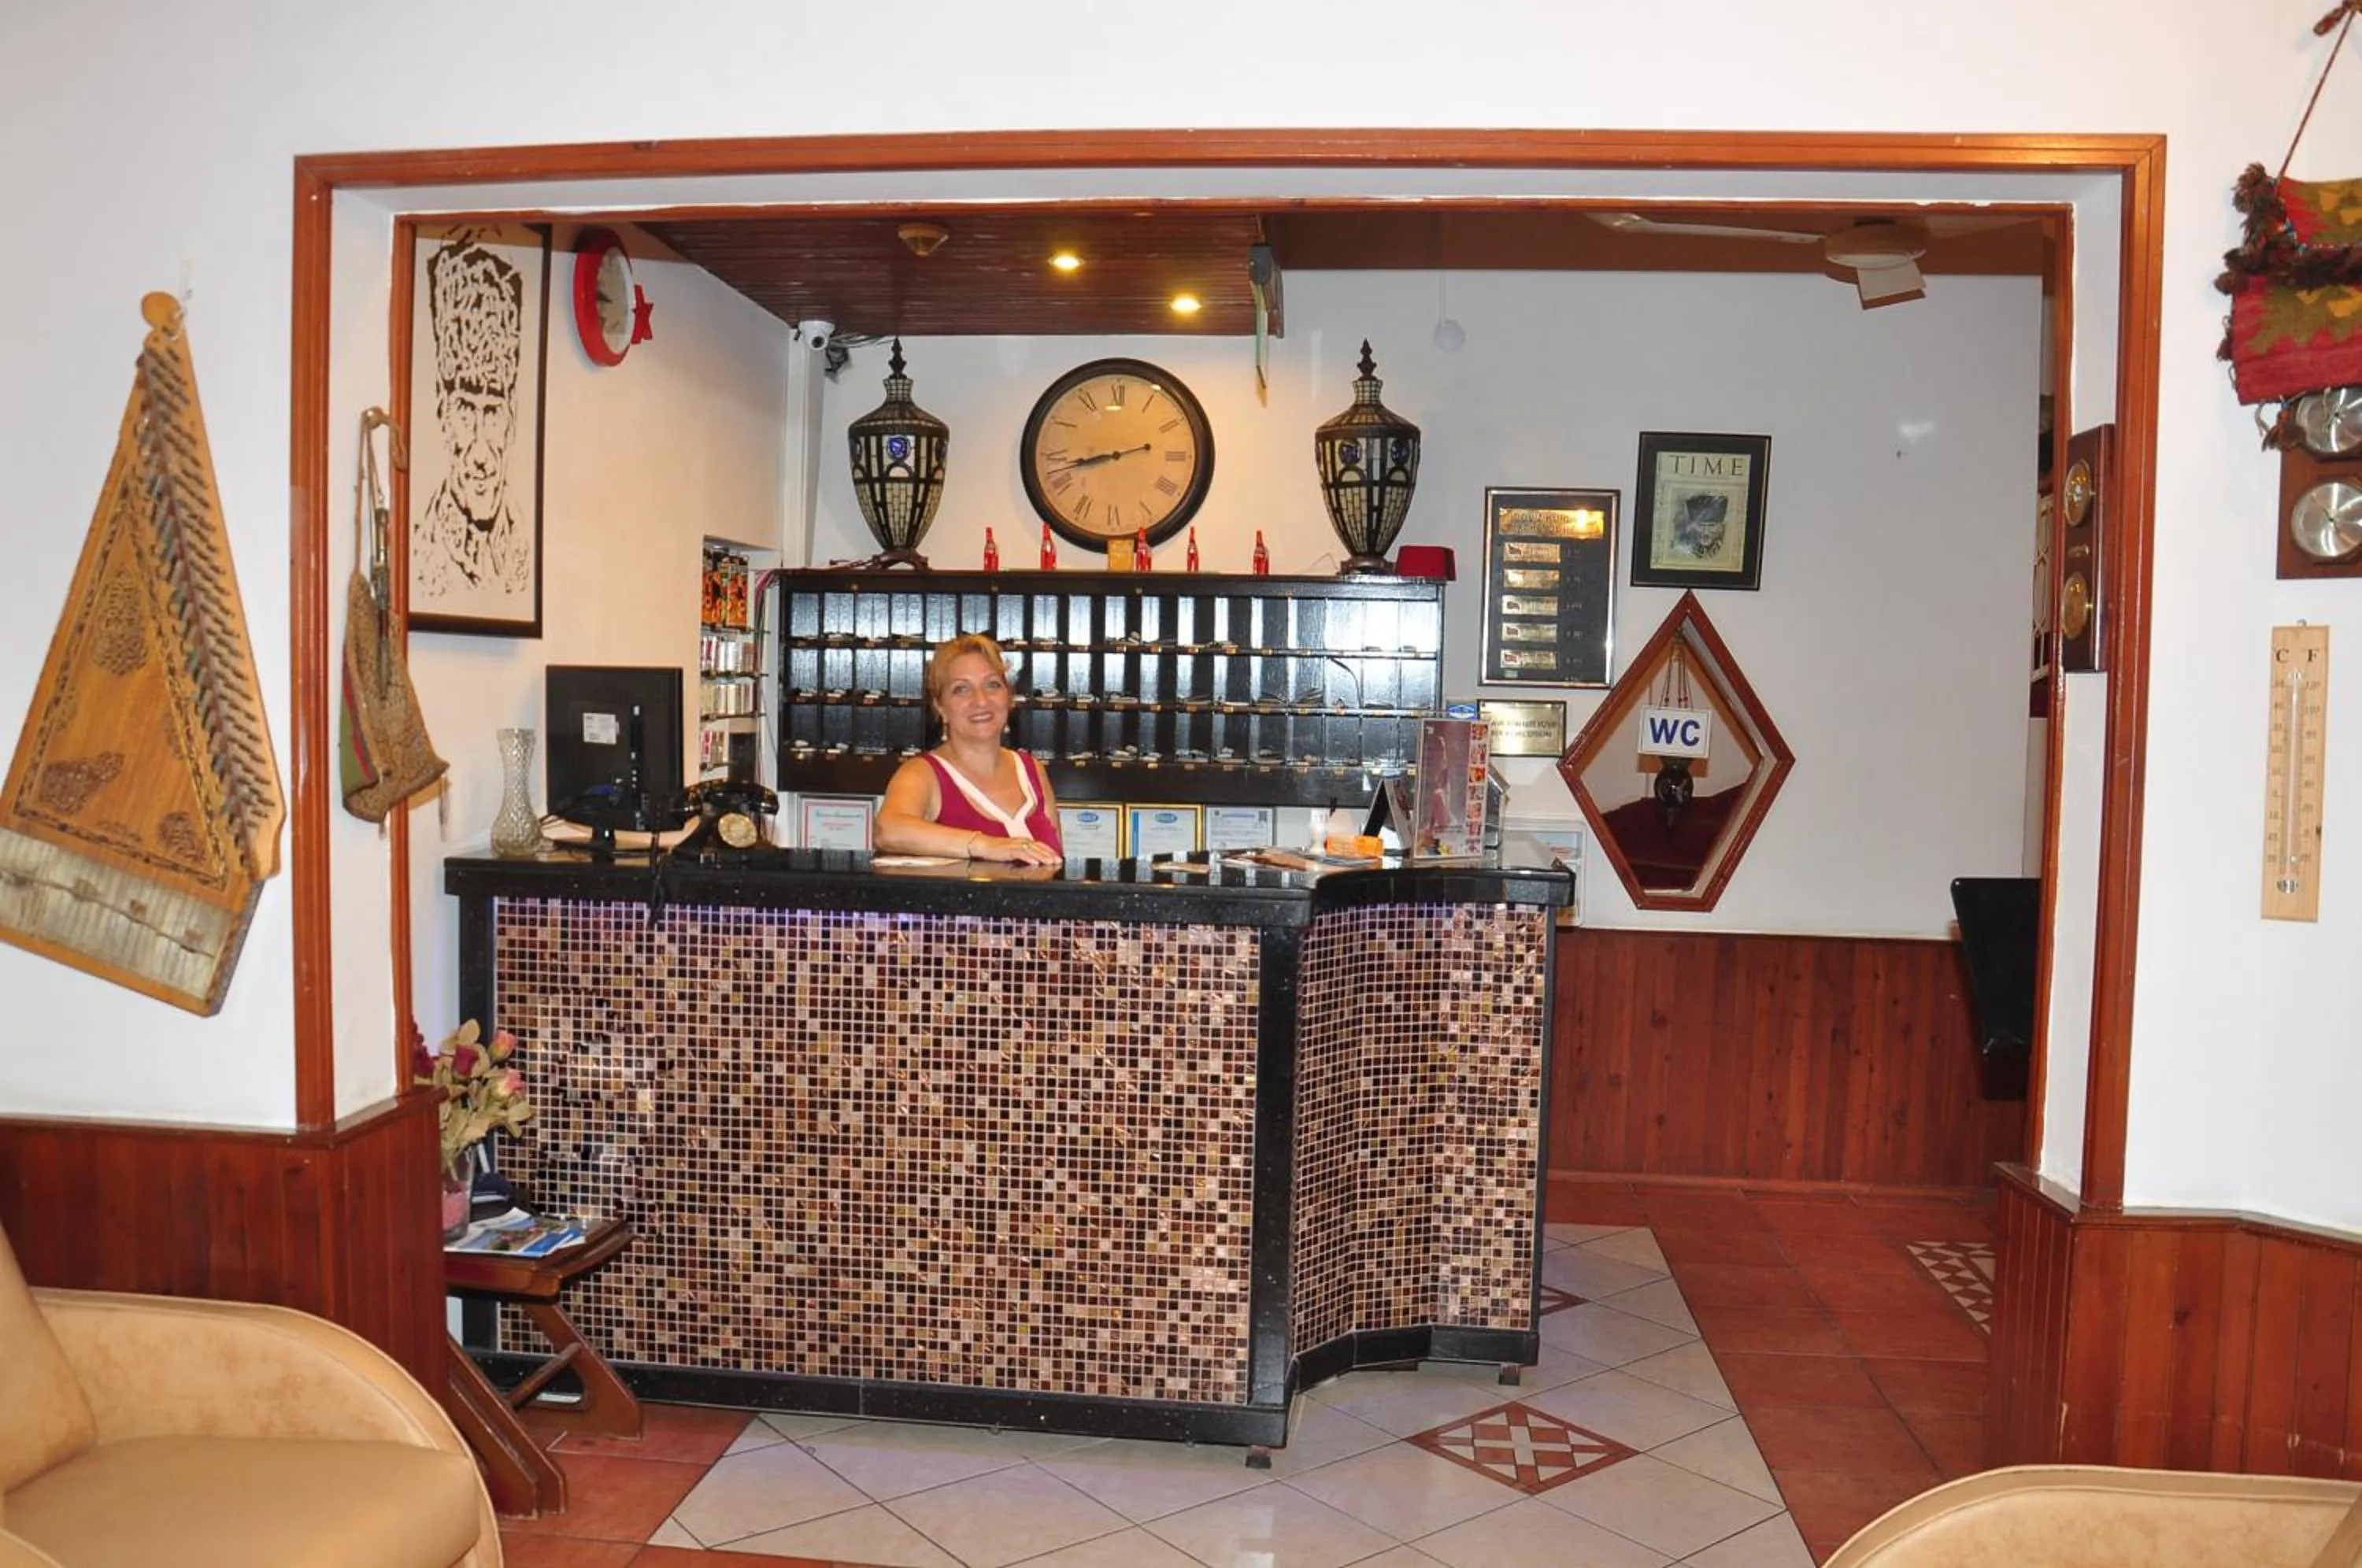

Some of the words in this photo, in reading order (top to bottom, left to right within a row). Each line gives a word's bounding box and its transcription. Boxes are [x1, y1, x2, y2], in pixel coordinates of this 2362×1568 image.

[1142, 394, 1154, 413] I
[1158, 418, 1179, 435] II
[1165, 451, 1187, 462] III
[1669, 454, 1743, 476] TIME
[2275, 648, 2290, 664] C
[2303, 648, 2319, 663] F
[1649, 717, 1700, 747] WC
